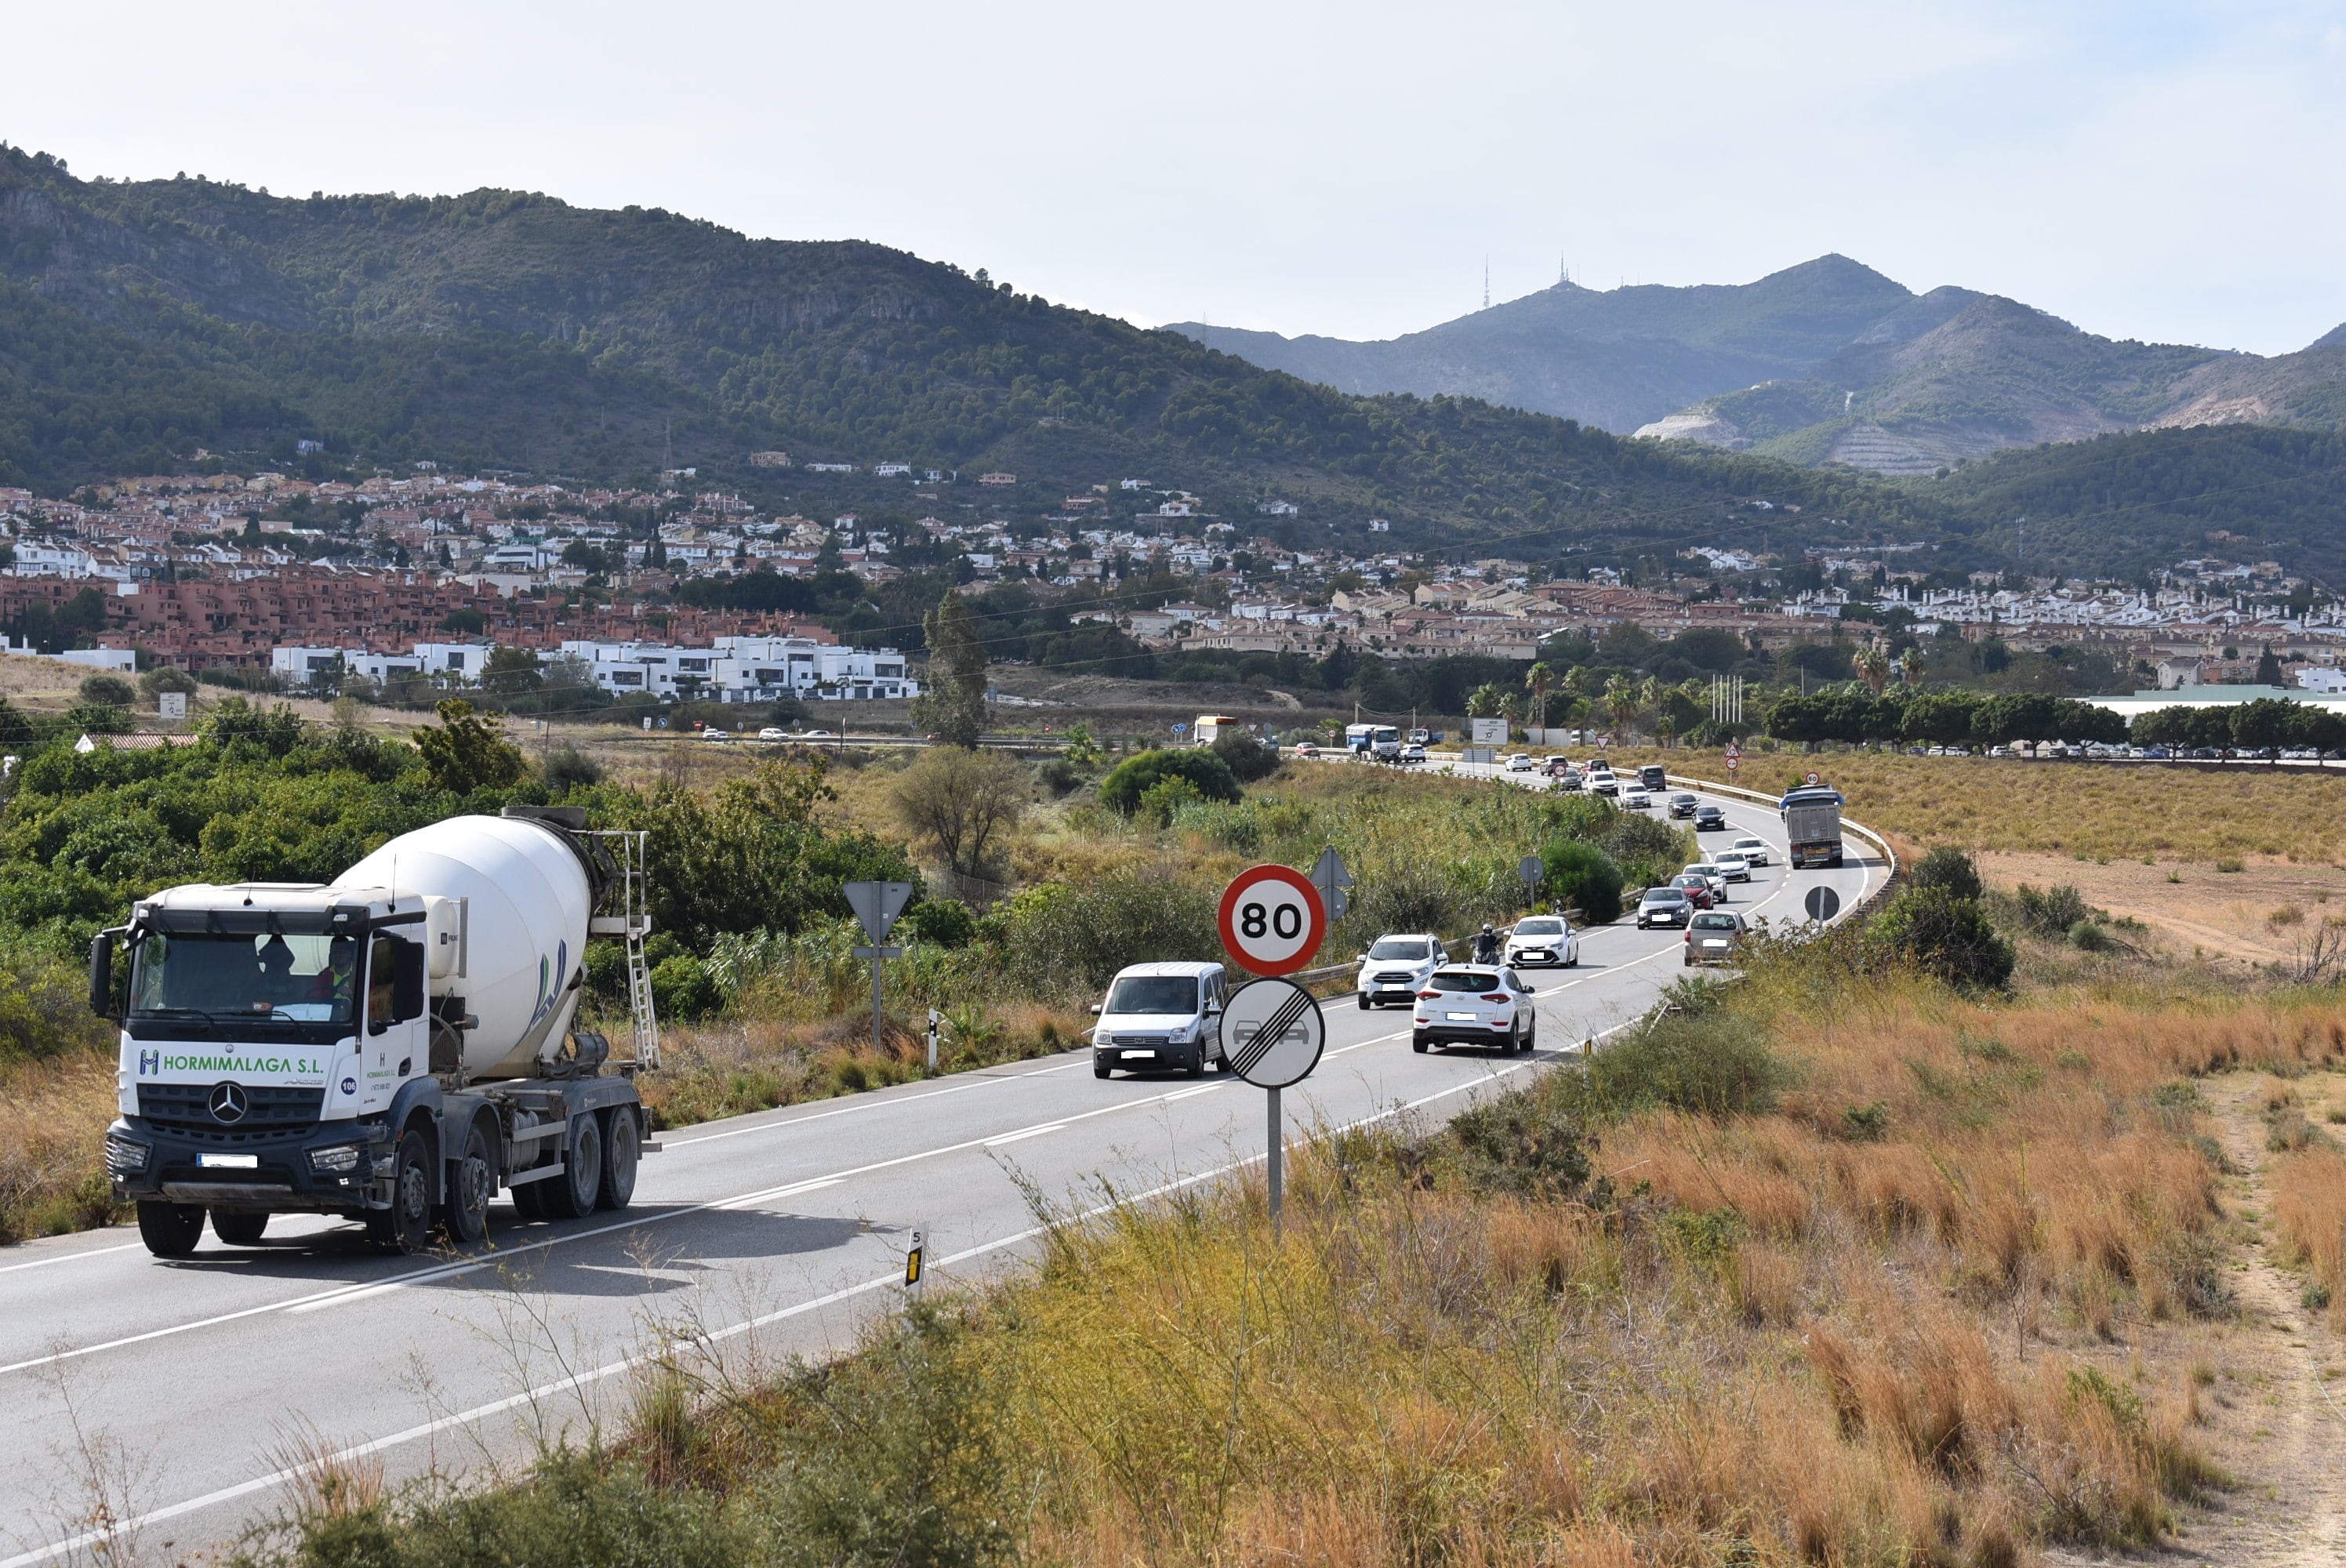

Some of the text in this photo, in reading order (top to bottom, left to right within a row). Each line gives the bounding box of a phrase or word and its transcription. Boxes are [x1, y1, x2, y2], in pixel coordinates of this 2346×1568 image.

[1241, 902, 1302, 939] 80
[163, 1055, 292, 1073] HORMIMALAGA
[298, 1058, 324, 1073] S.L.
[342, 1082, 356, 1091] 106
[913, 1232, 920, 1243] 5
